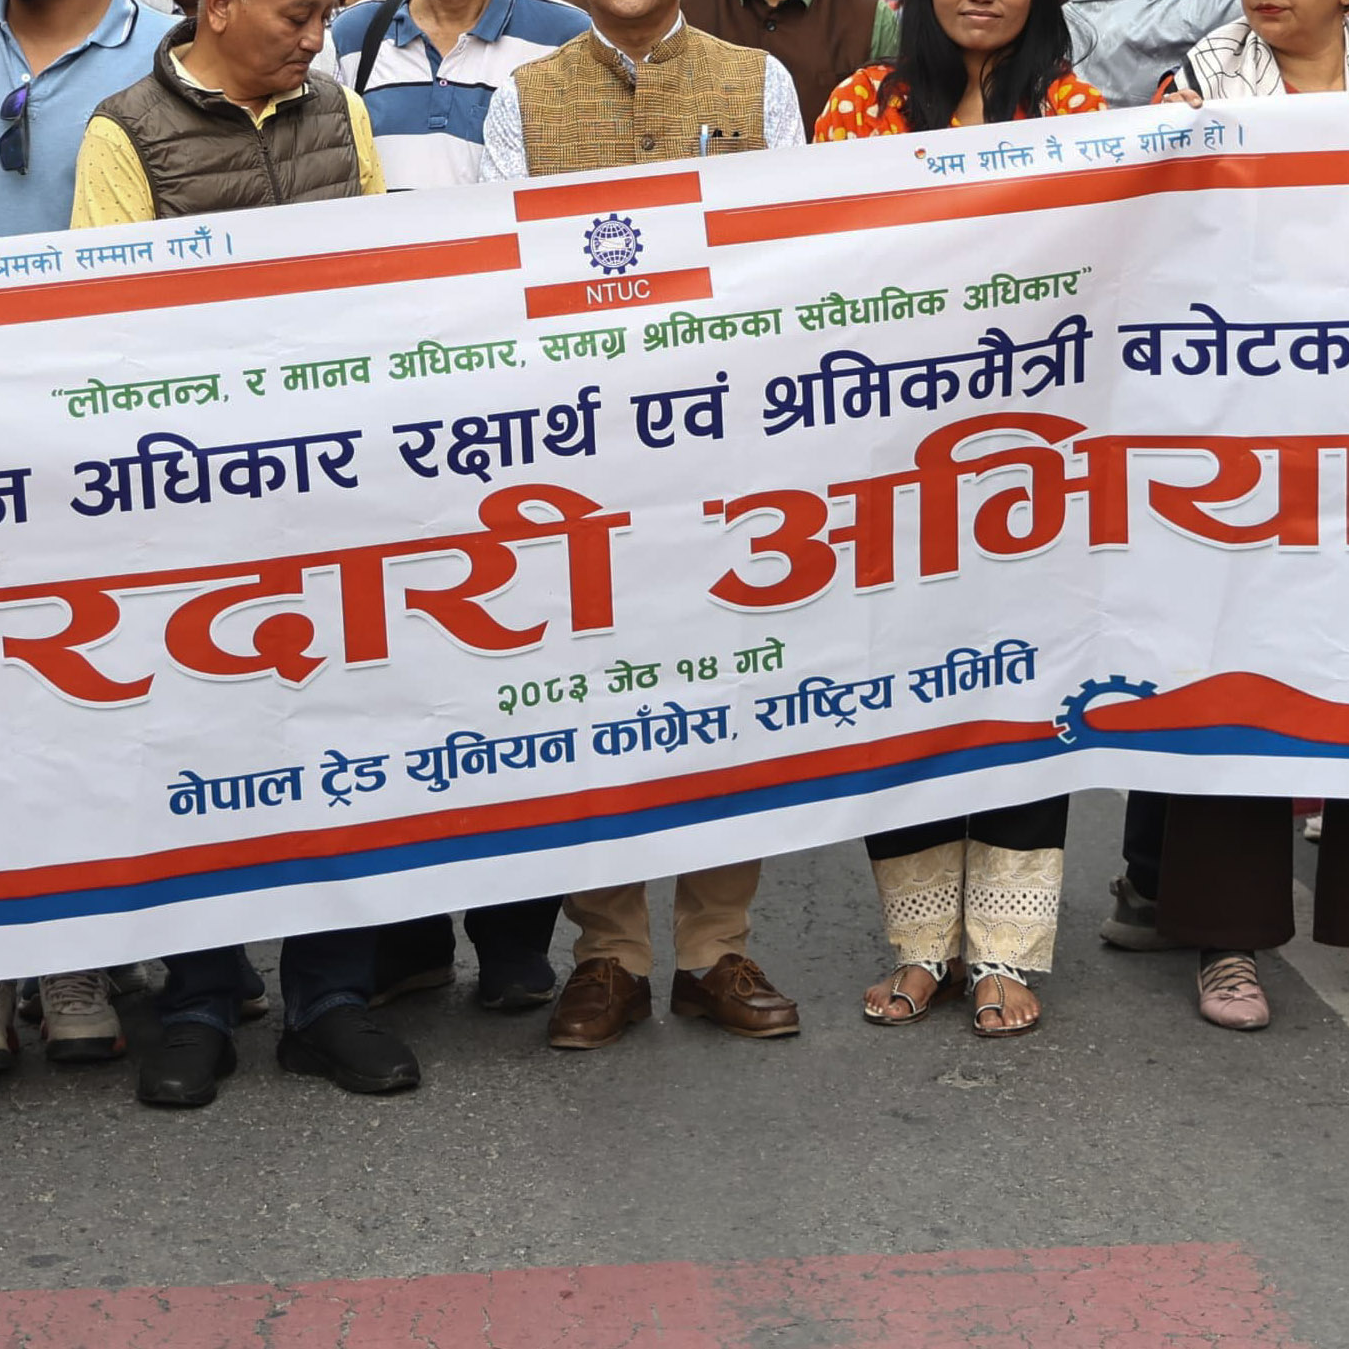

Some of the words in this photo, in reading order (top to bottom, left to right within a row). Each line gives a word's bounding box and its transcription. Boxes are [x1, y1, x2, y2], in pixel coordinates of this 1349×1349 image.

[927, 154, 966, 177] श्रम
[979, 141, 1034, 171] शक्ति
[1045, 135, 1063, 163] नै
[1075, 136, 1125, 163] राष्ट्र
[1137, 124, 1193, 153] शक्ति
[1203, 120, 1225, 148] हो
[76, 241, 153, 270] सम्मान
[586, 279, 650, 305] NTUC
[243, 369, 266, 397] र
[280, 356, 372, 392] मानव
[388, 340, 526, 380] अधिकार,
[539, 326, 627, 361] समग्र
[643, 307, 782, 352] श्रमिकका
[796, 287, 949, 332] संवैधानिक
[70, 429, 362, 520] अधिकार
[393, 385, 602, 483] रक्षार्थ
[631, 370, 731, 449] एवं
[762, 313, 1093, 436] श्रमिकमैत्री
[497, 673, 589, 714] २०८३
[605, 660, 661, 694] जेठ
[676, 655, 719, 684] १४
[733, 637, 786, 674] गते
[166, 765, 305, 816] नेपाल
[320, 749, 390, 807] ट्रेड
[405, 731, 577, 792] युनियन
[755, 675, 896, 727] राष्ट्रिय
[907, 638, 1038, 704] समिति
